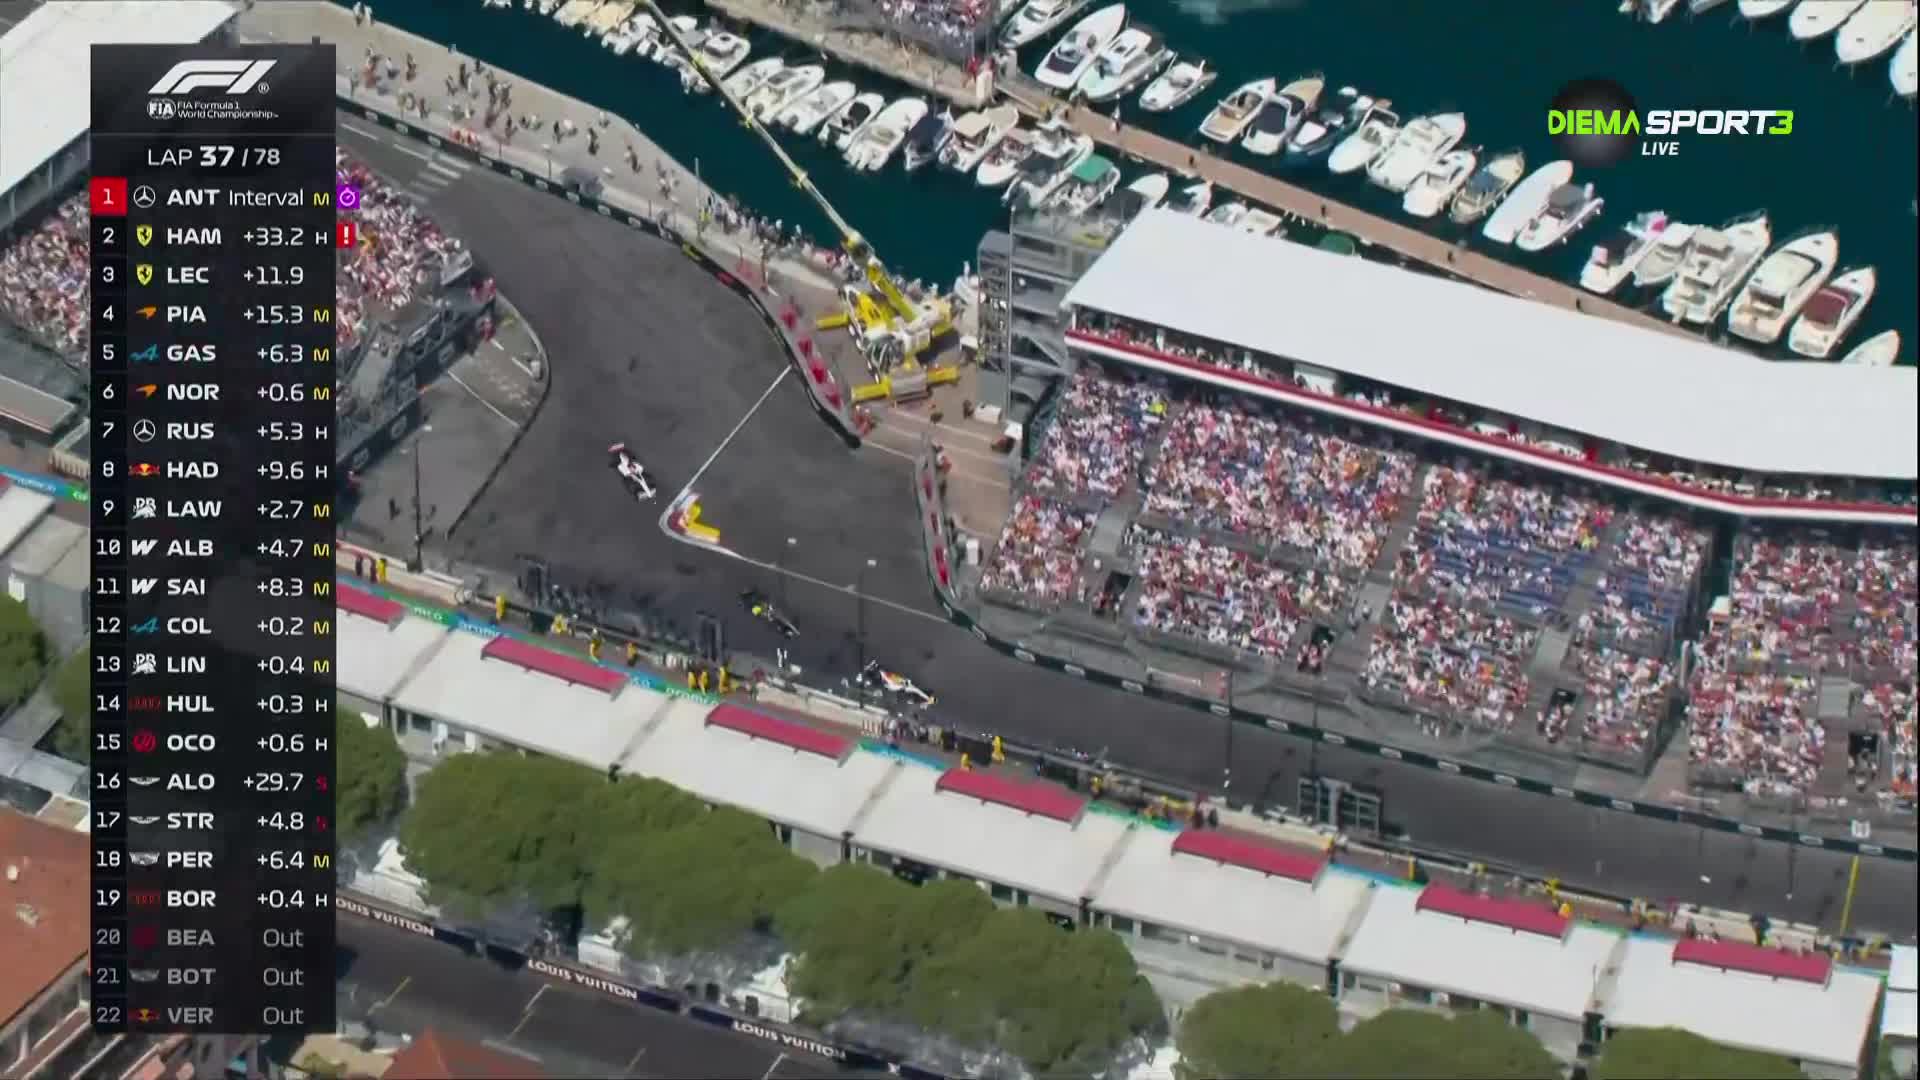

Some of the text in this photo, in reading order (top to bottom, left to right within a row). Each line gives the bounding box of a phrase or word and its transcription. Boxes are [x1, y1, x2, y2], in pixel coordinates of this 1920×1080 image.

[336, 897, 369, 917] OUIS
[528, 959, 638, 999] LOUIS VUITTON
[734, 1020, 778, 1041] LOUIS
